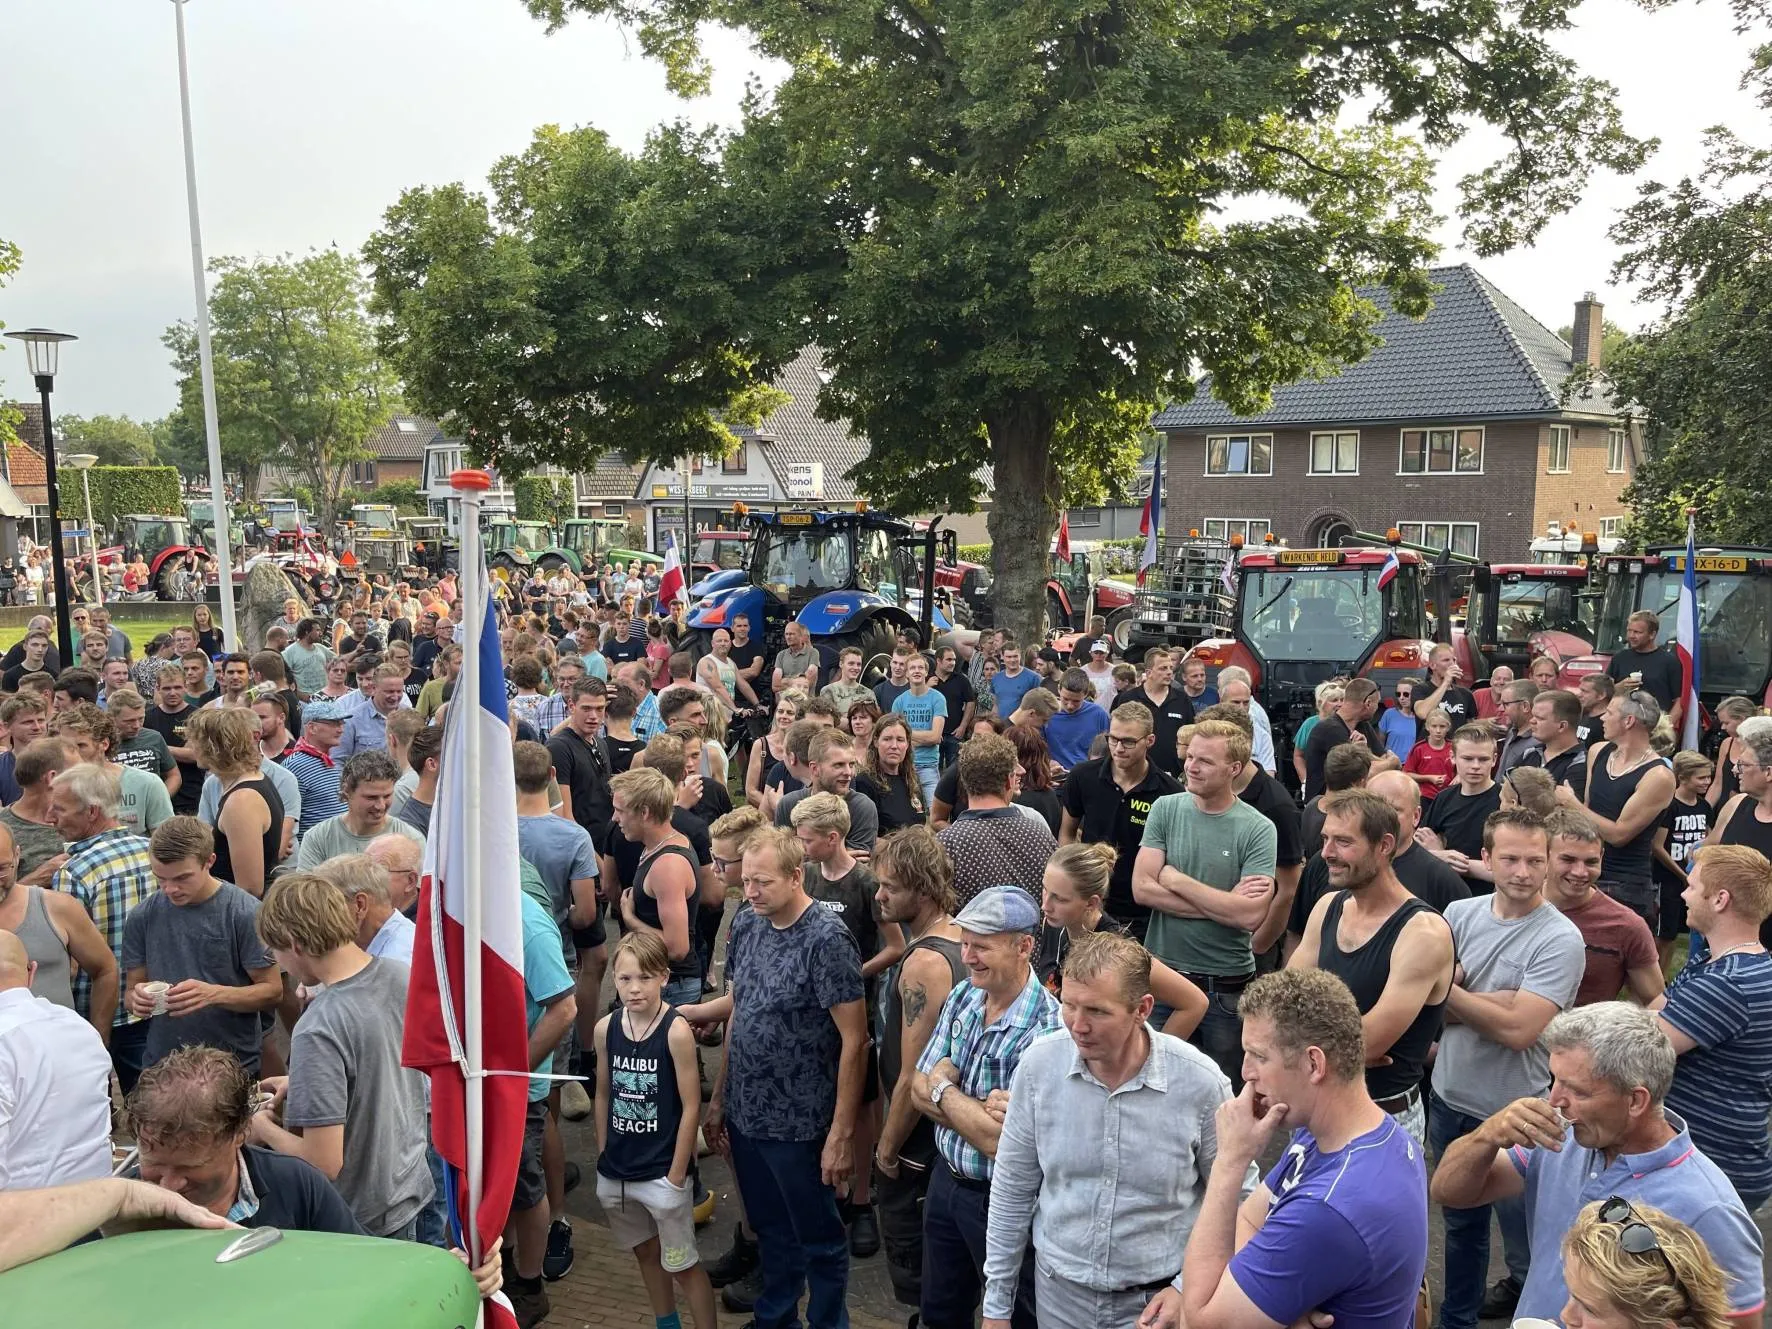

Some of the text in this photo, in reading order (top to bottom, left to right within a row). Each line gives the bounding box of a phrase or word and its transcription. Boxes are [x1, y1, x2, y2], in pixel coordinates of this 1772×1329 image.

[1320, 551, 1337, 562] HELD
[1681, 558, 1741, 570] TX-16-D
[1130, 798, 1152, 813] WD
[612, 1054, 658, 1073] MALIBU
[612, 1115, 658, 1134] BEACH
